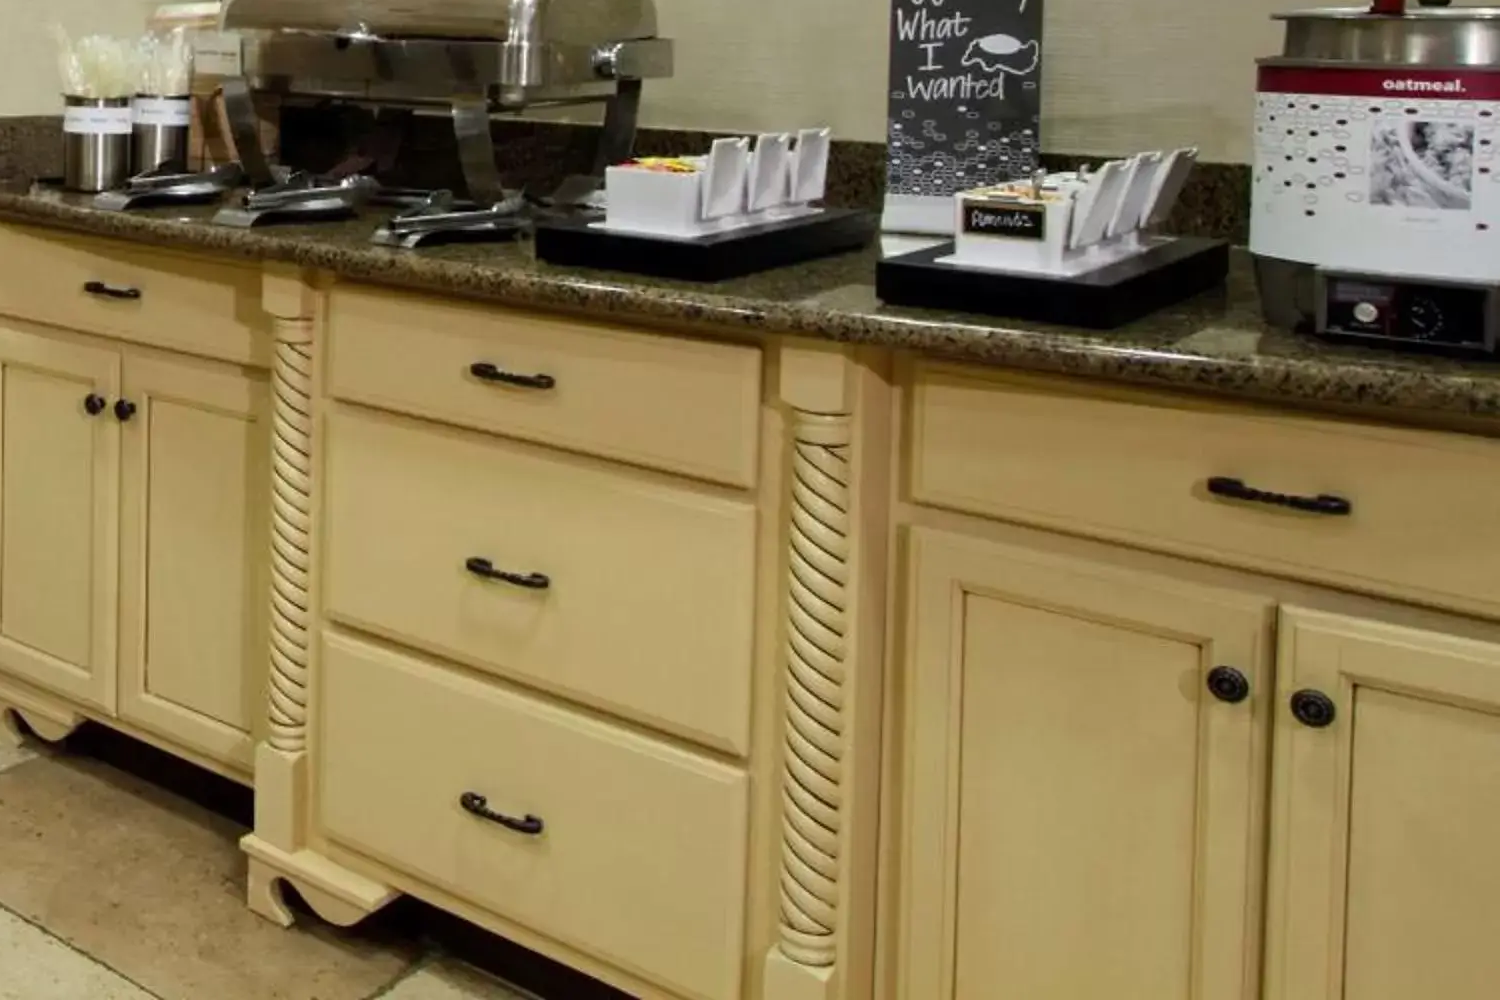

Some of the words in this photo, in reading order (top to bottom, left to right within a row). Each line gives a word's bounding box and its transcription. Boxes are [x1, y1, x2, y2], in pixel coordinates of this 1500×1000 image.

[896, 7, 971, 41] What
[917, 41, 944, 71] I
[906, 71, 1003, 101] wanted
[1381, 78, 1466, 93] oatmeal.
